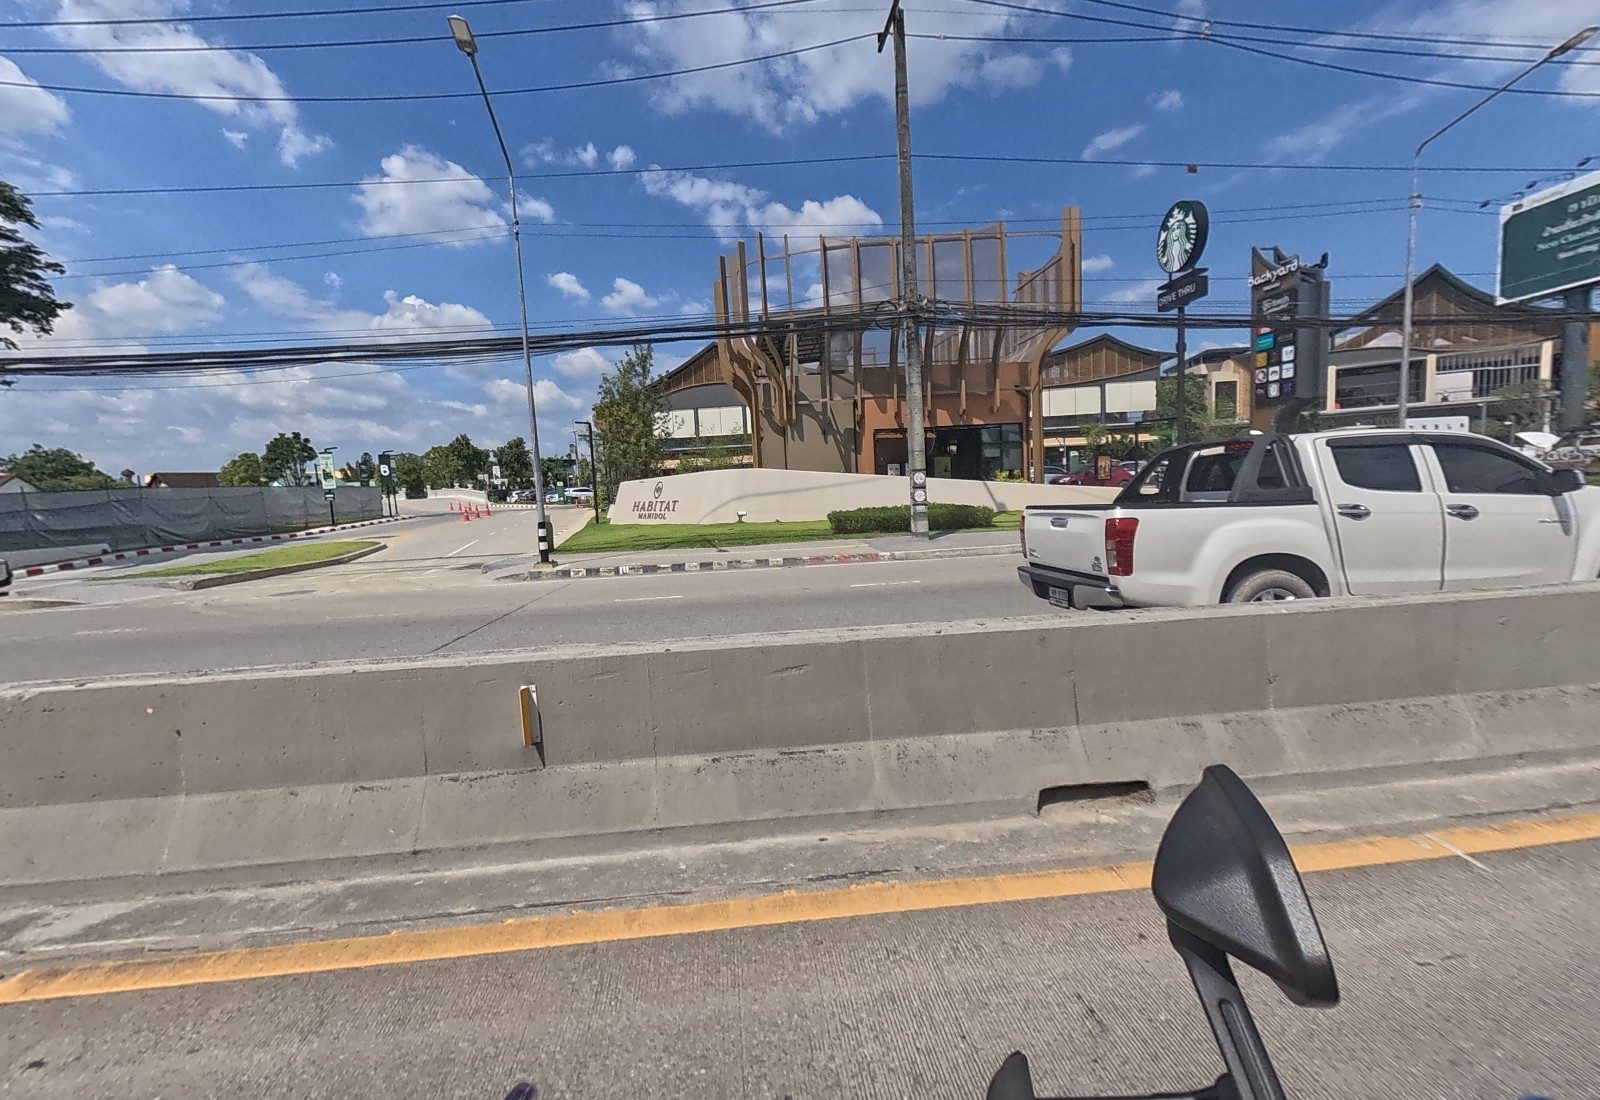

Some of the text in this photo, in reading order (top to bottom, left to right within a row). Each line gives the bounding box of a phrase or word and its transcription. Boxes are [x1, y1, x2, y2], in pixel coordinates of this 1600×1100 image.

[1159, 282, 1196, 307] DRIVE THRU
[632, 500, 679, 512] HABITAT
[638, 512, 667, 520] MAHIDOL
